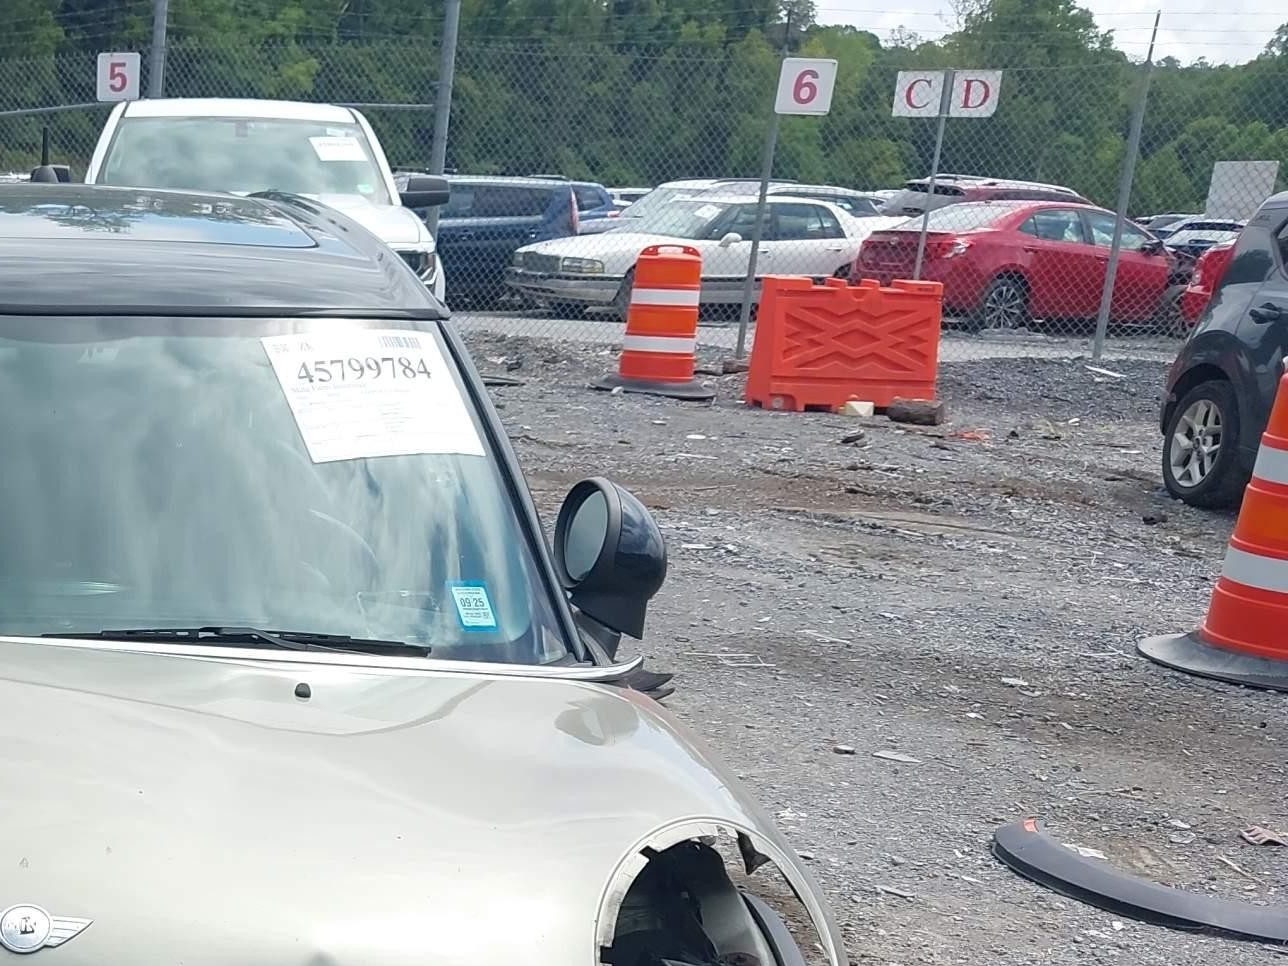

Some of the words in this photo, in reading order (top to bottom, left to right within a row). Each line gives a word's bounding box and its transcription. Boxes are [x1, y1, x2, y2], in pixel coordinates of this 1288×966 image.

[109, 62, 127, 92] 5
[792, 69, 820, 105] 6
[905, 78, 932, 109] C
[959, 79, 991, 109] D
[297, 356, 432, 383] 45799784
